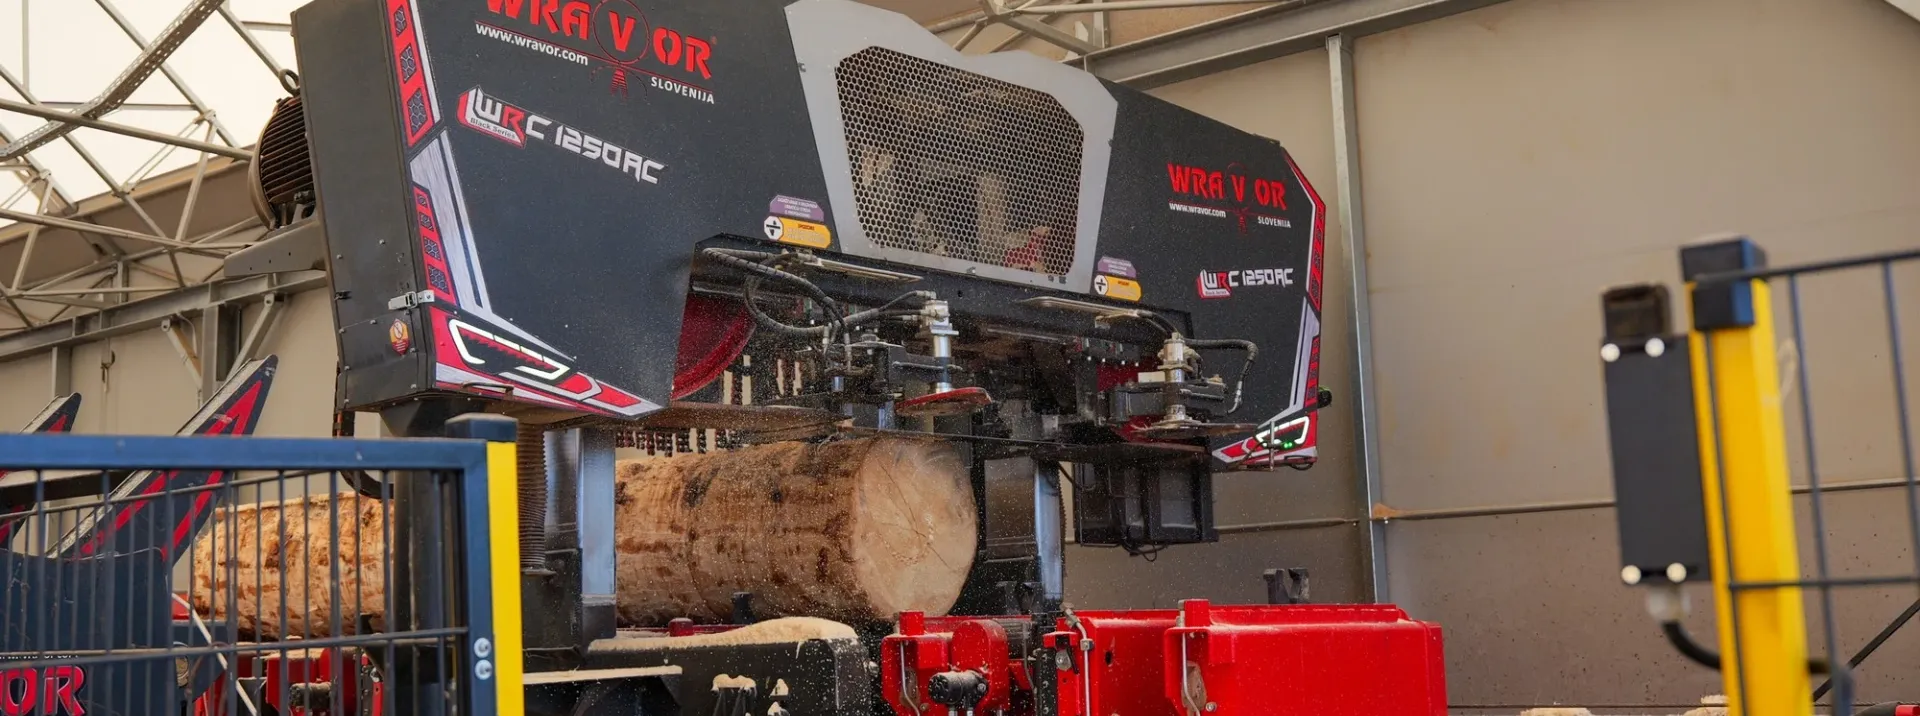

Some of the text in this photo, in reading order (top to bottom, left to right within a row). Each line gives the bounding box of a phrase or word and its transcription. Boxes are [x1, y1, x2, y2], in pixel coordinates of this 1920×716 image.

[475, 23, 589, 66] www.wravor.com
[651, 76, 715, 105] SLOVENIJA
[470, 117, 516, 139] Black Series
[1167, 162, 1287, 211] WRAVOR
[1168, 202, 1227, 219] www.wravor.com
[1257, 216, 1292, 228] SLOVENIJA
